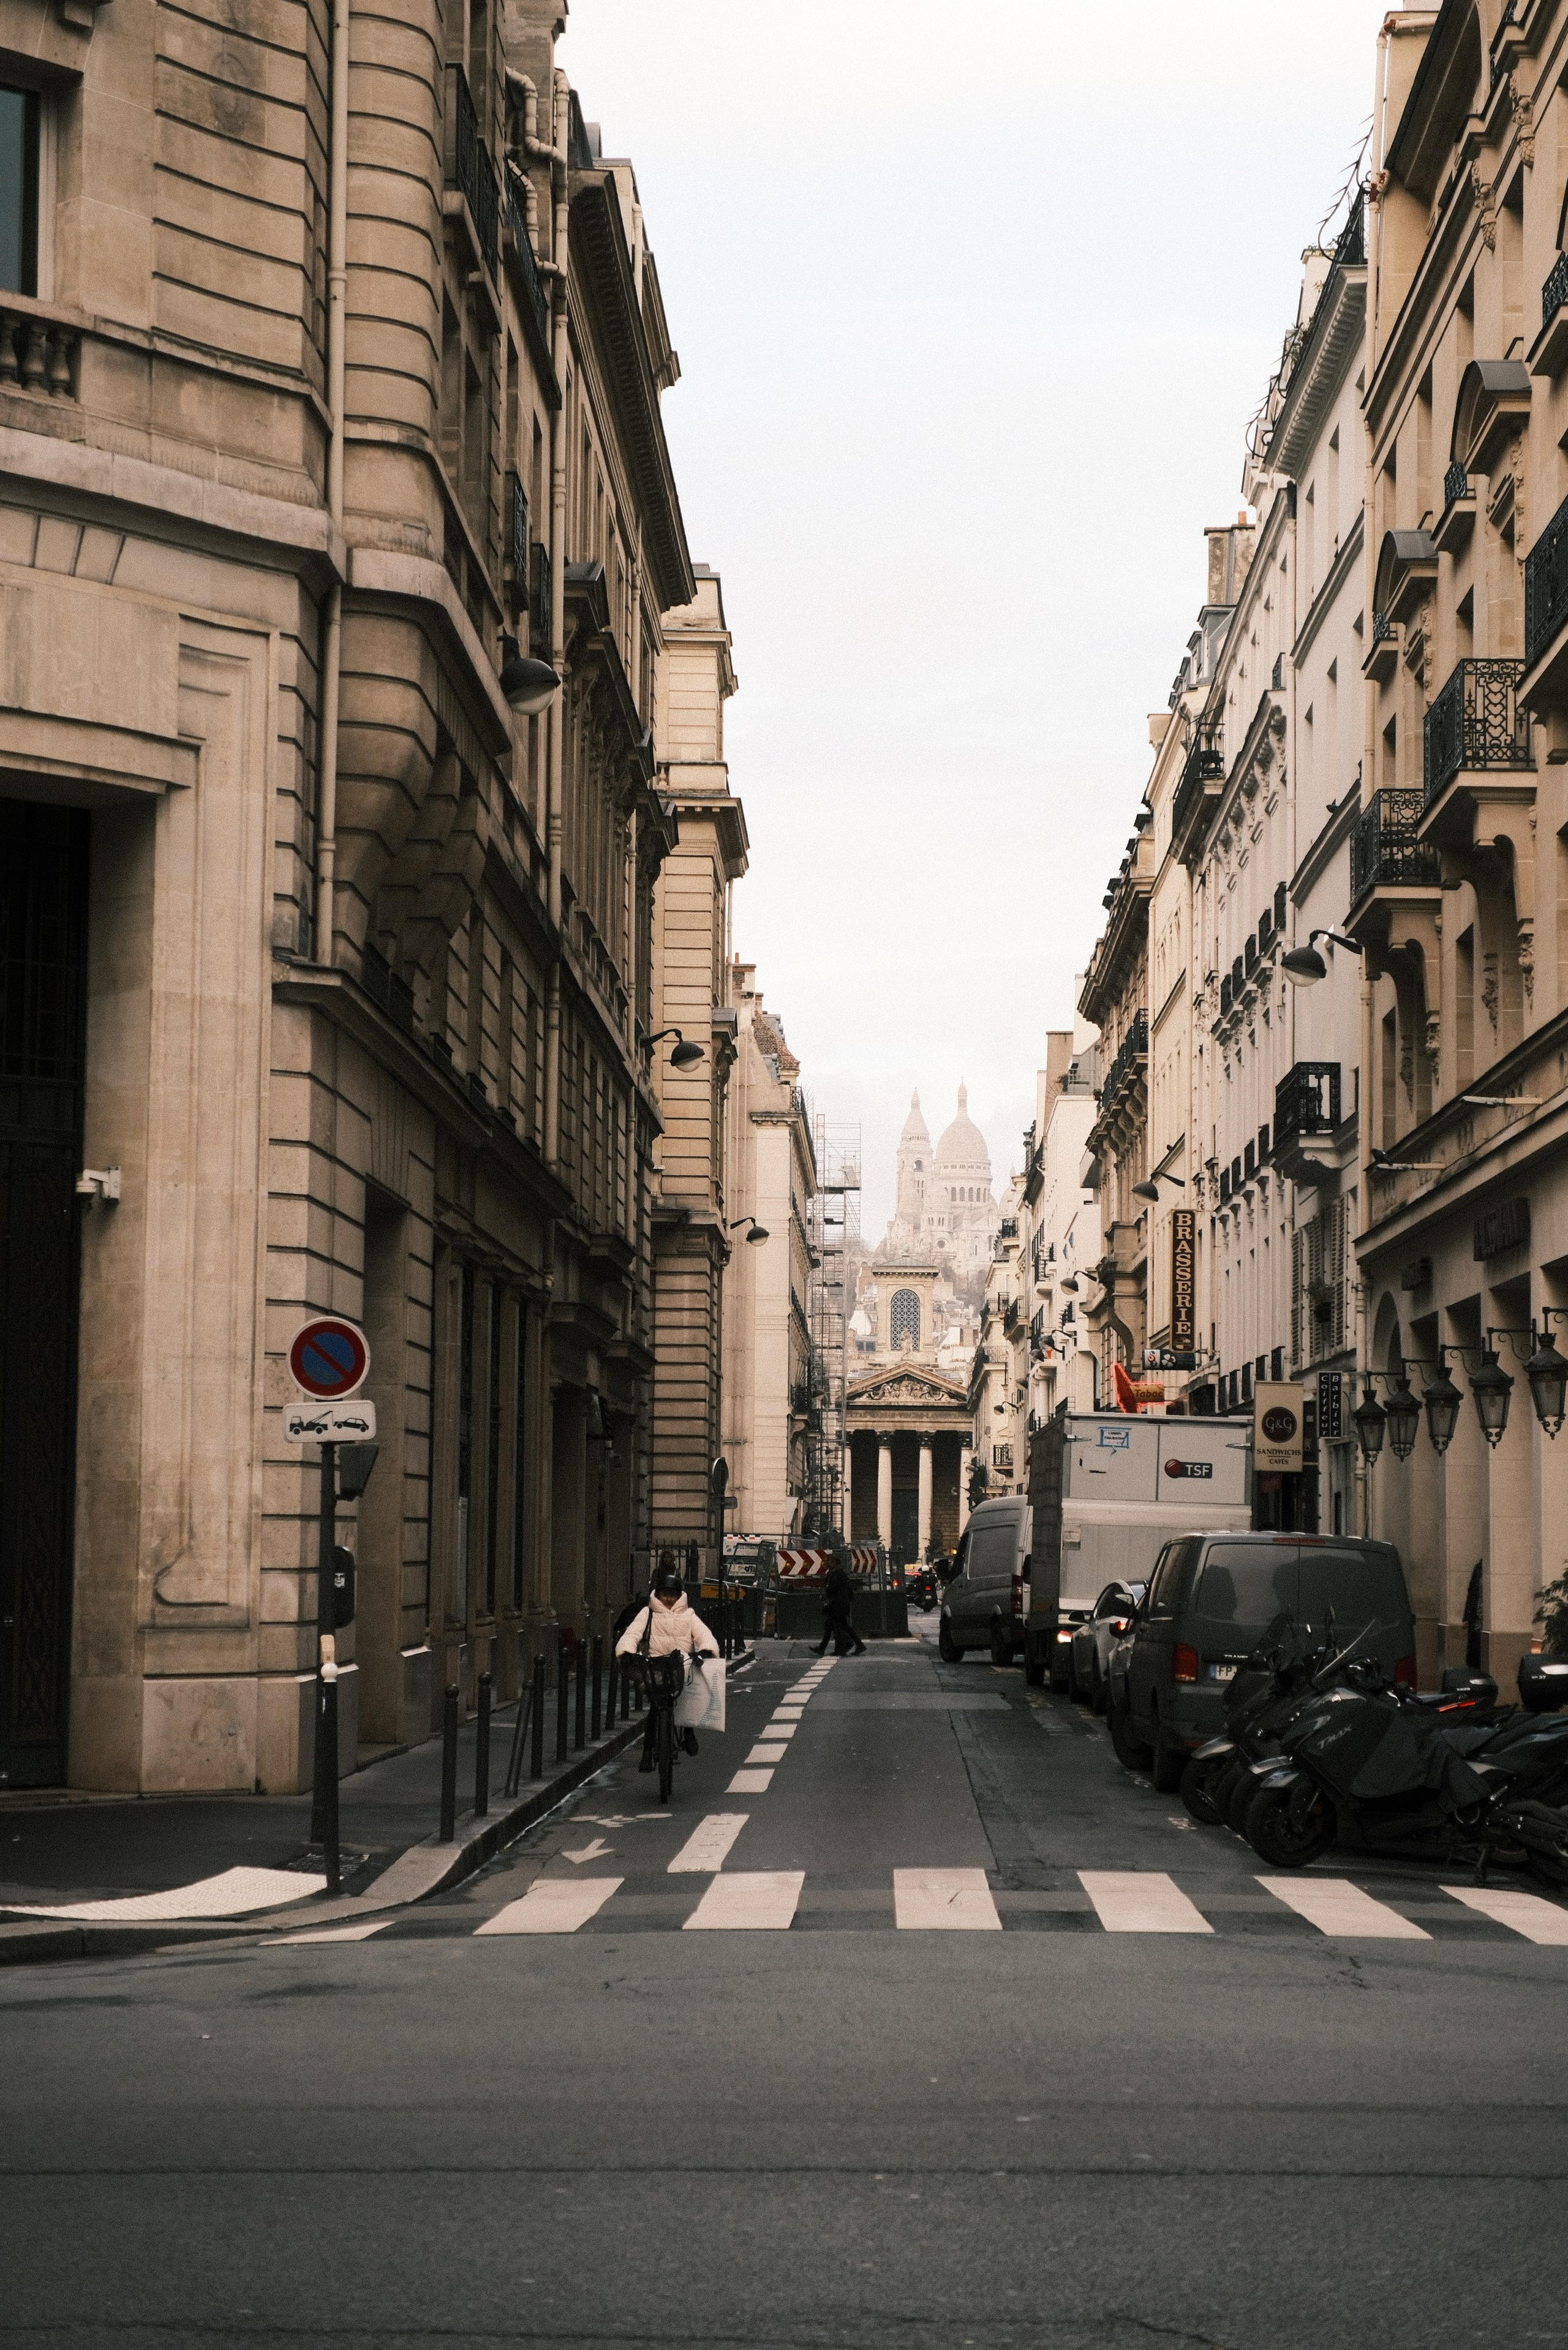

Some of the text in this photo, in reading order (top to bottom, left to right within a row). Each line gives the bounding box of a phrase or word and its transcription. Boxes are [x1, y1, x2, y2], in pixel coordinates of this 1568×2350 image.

[1175, 1213, 1193, 1335] BRASSERIE
[1134, 1388, 1164, 1398] Tabac
[1265, 1416, 1292, 1434] G&G
[1185, 1464, 1210, 1476] TSF
